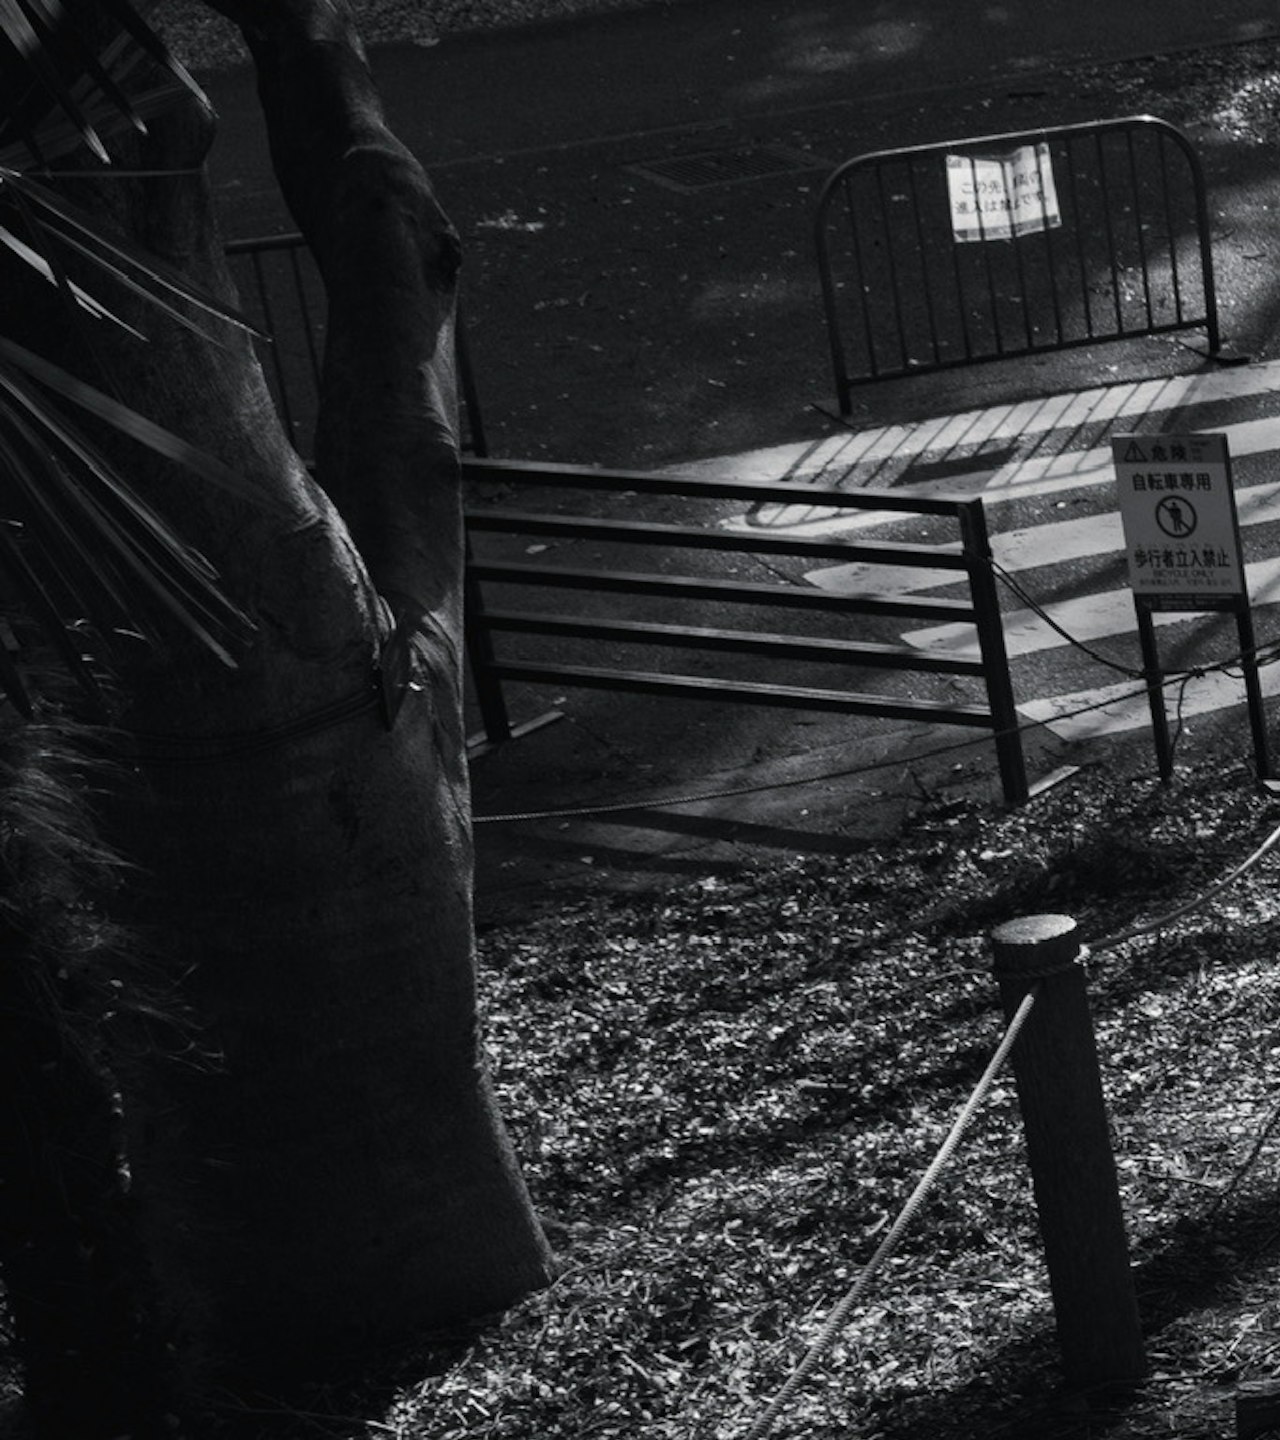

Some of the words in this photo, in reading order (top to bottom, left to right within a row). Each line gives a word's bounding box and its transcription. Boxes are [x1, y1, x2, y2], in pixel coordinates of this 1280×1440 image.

[1151, 445, 1187, 462] 危険
[1132, 472, 1212, 491] 自転車専用
[1134, 547, 1231, 569] 歩行者立入禁止
